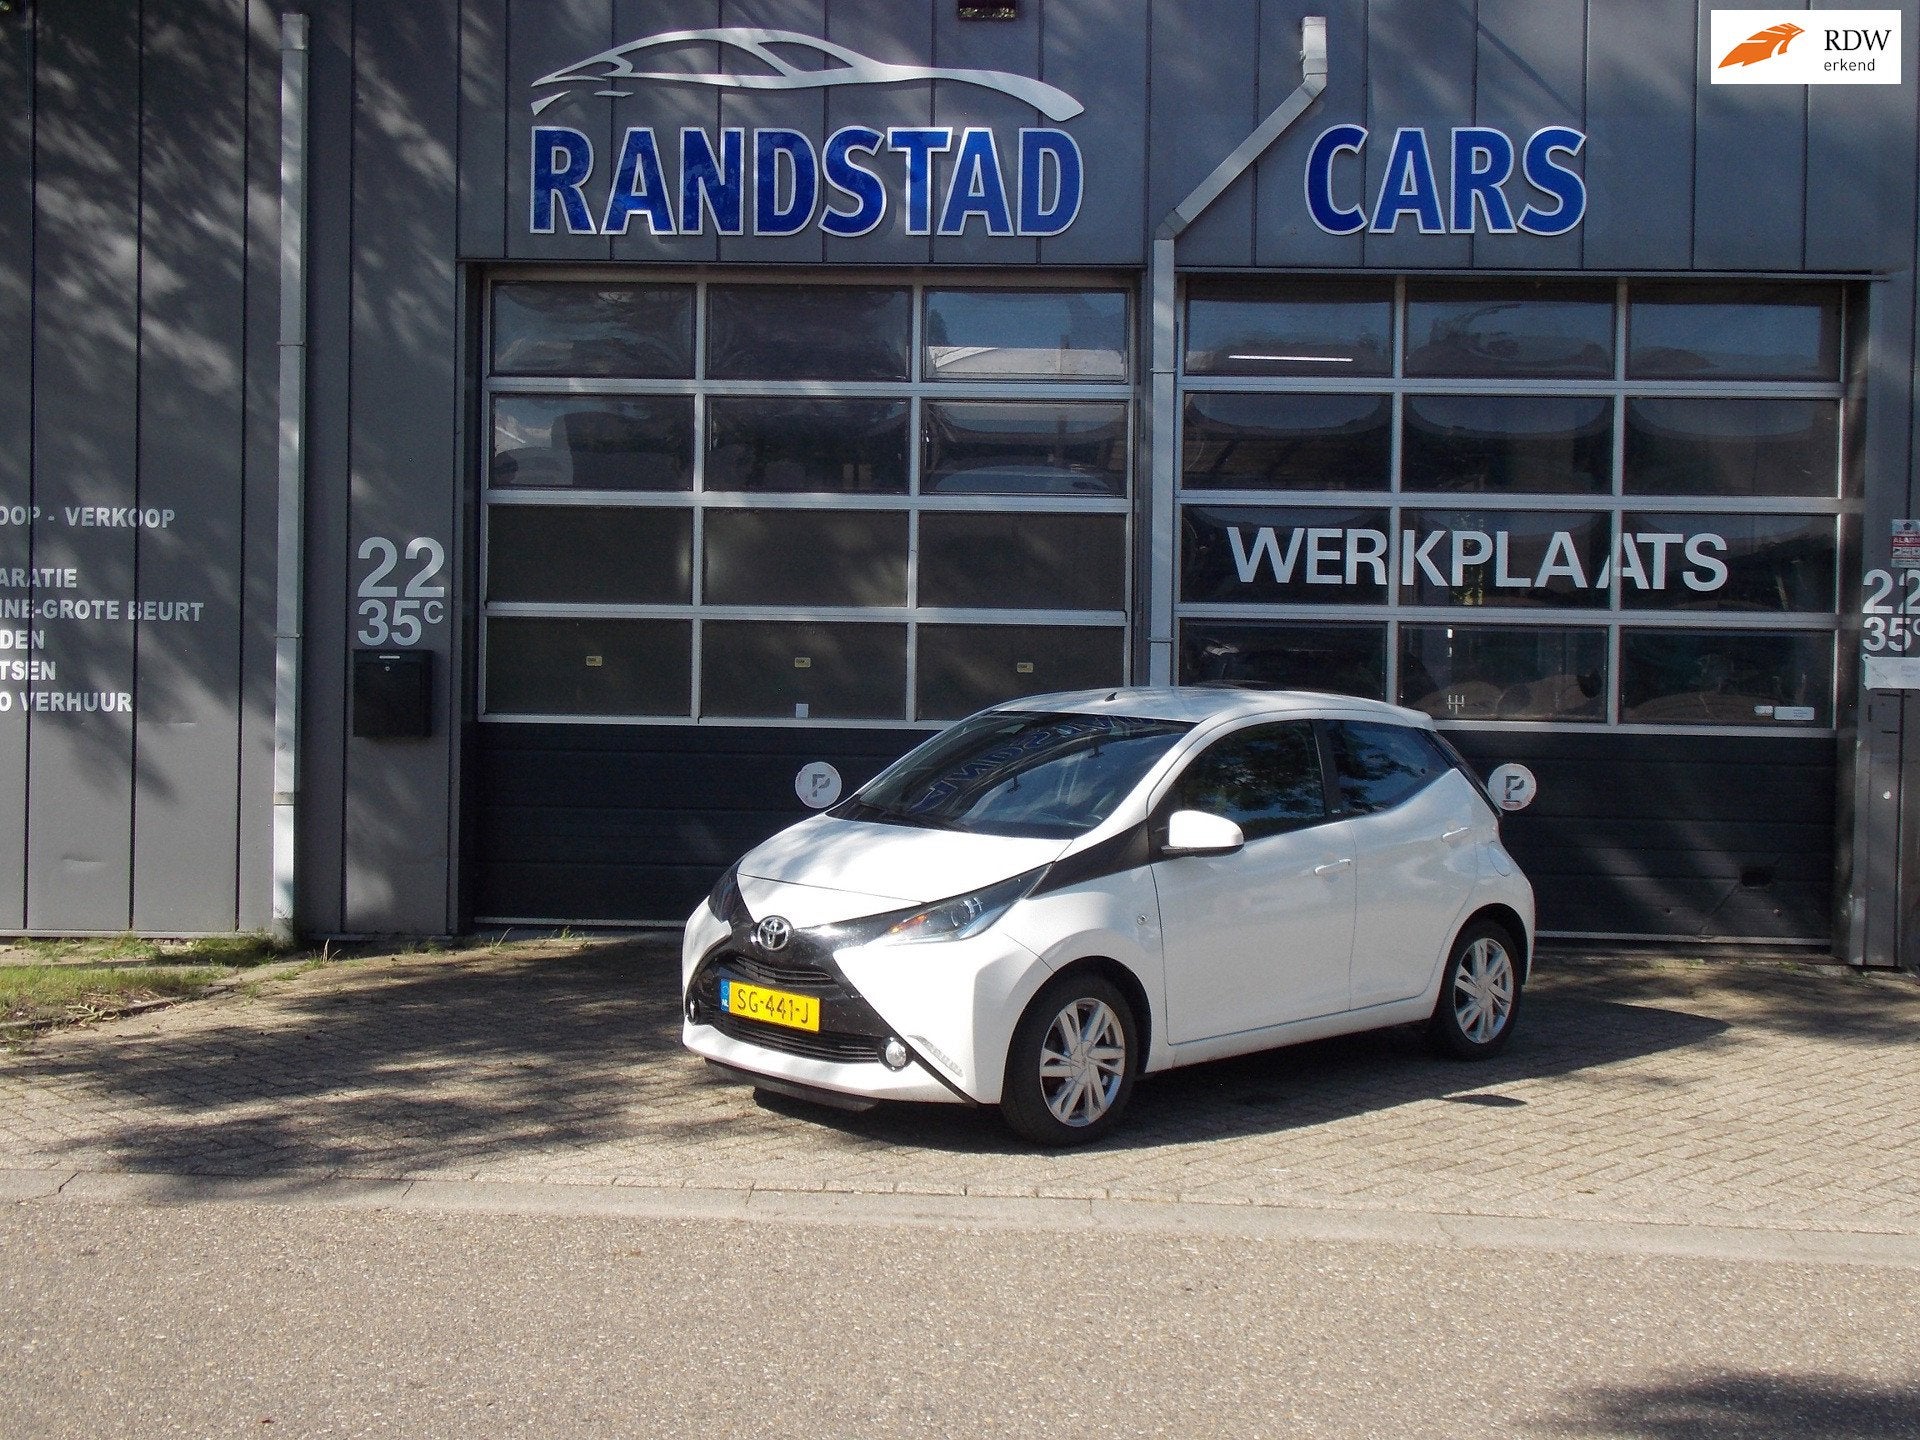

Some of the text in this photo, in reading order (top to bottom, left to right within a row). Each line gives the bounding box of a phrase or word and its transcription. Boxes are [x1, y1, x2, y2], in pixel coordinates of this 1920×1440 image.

[530, 123, 1587, 238] RANDSTAD CARS
[65, 507, 175, 528] VERKOOP
[357, 536, 445, 598] 22
[1226, 526, 1729, 592] WERKPLAATS
[0, 568, 77, 588] ARATIE
[1862, 569, 1920, 615] 22
[128, 601, 204, 621] BEURT
[0, 630, 44, 650] DEN
[0, 660, 56, 680] TSEN
[20, 692, 132, 712] VERHUUR
[737, 988, 809, 1025] SG-441-J
